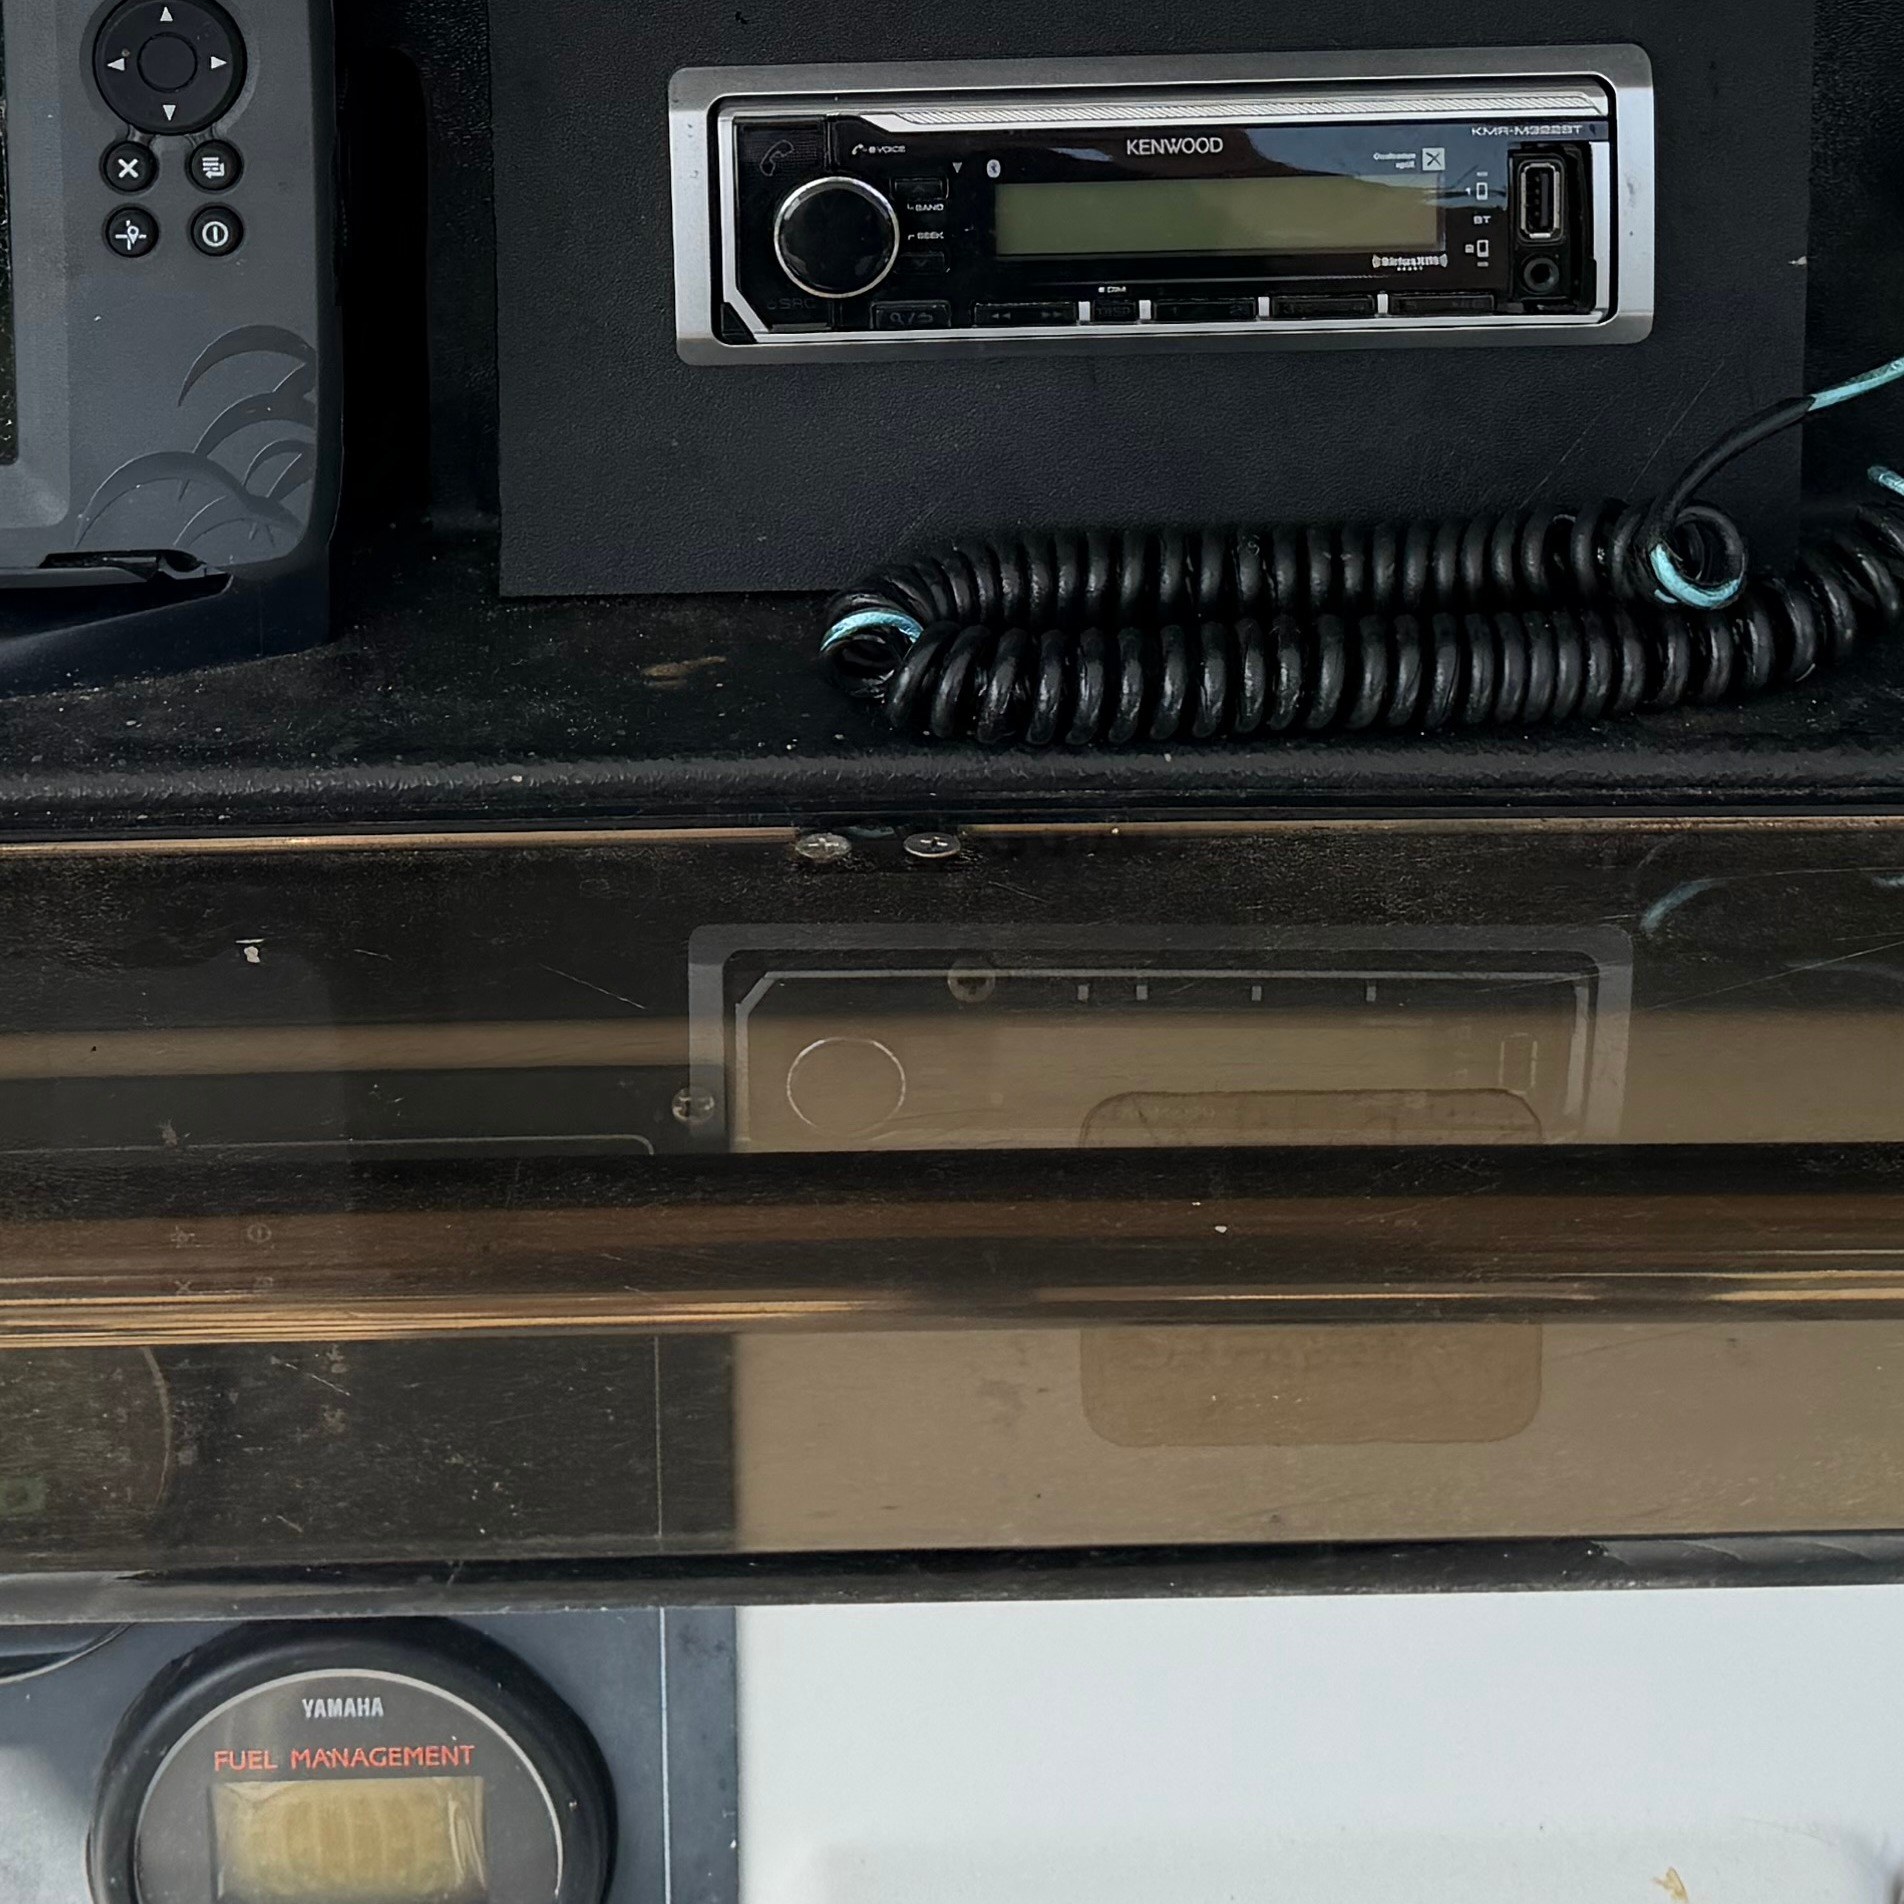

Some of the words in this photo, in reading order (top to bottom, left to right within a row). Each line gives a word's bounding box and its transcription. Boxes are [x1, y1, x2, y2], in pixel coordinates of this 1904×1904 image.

[1126, 136, 1224, 156] KENWOOD
[914, 203, 945, 212] BAND
[1472, 215, 1492, 225] BT
[301, 1696, 385, 1719] YAMAHA
[213, 1749, 279, 1773] FUEL
[289, 1744, 477, 1770] MANAGEMENT
